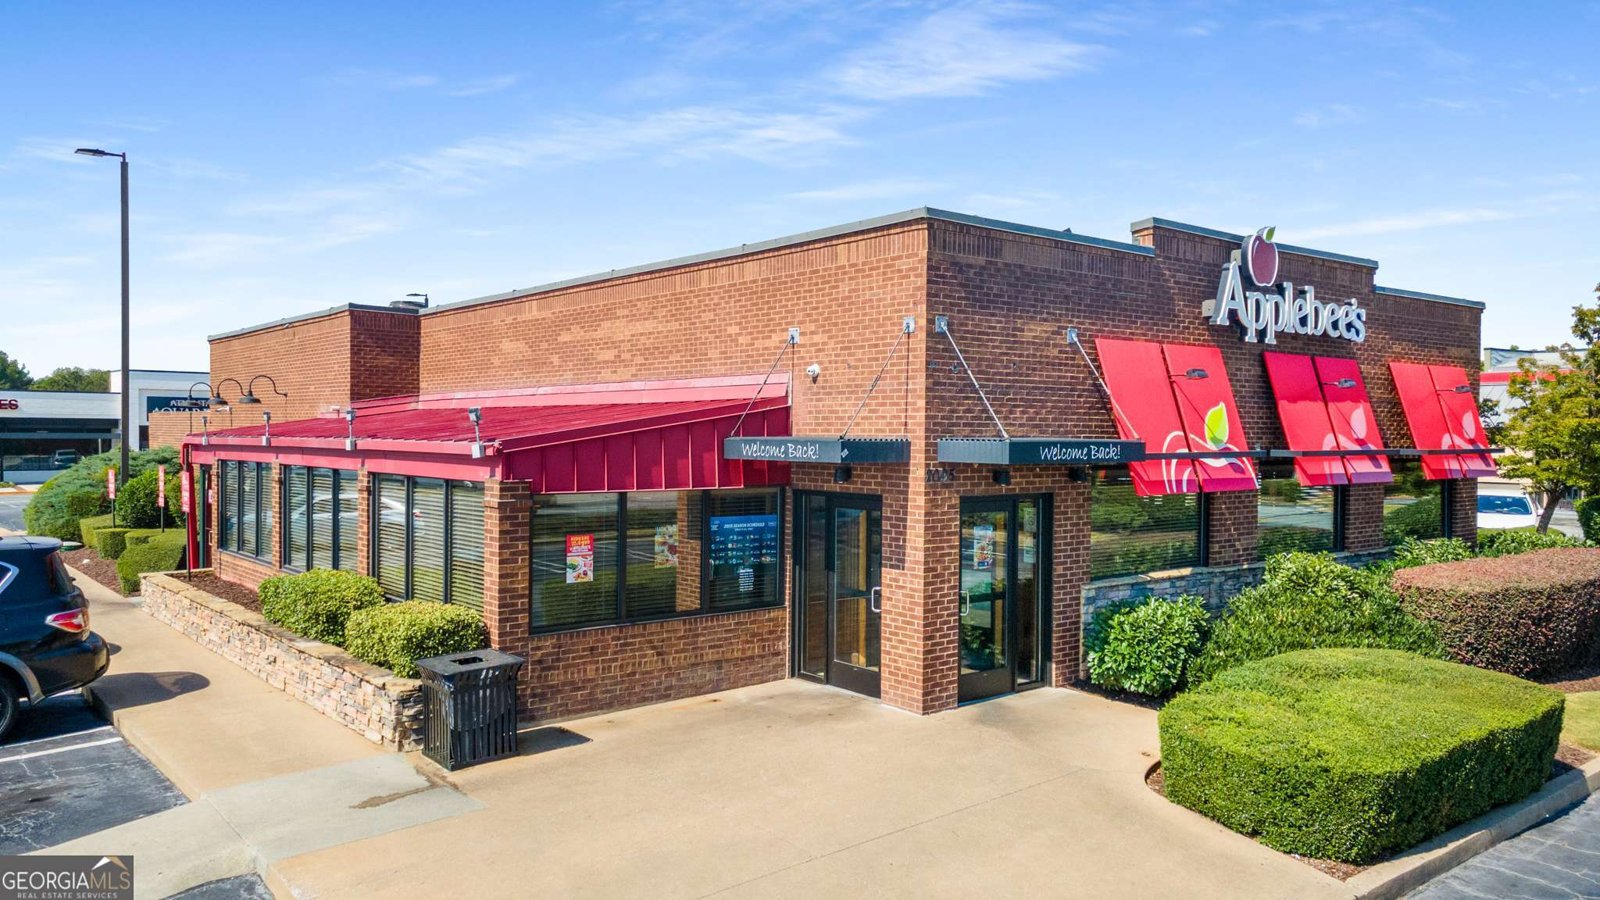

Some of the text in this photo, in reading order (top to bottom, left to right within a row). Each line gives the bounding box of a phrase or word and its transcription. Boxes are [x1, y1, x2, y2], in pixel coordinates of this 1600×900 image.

[1209, 261, 1367, 344] Applebee's
[742, 442, 819, 459] Welcome Back!
[1039, 444, 1121, 461] Welcome Back!
